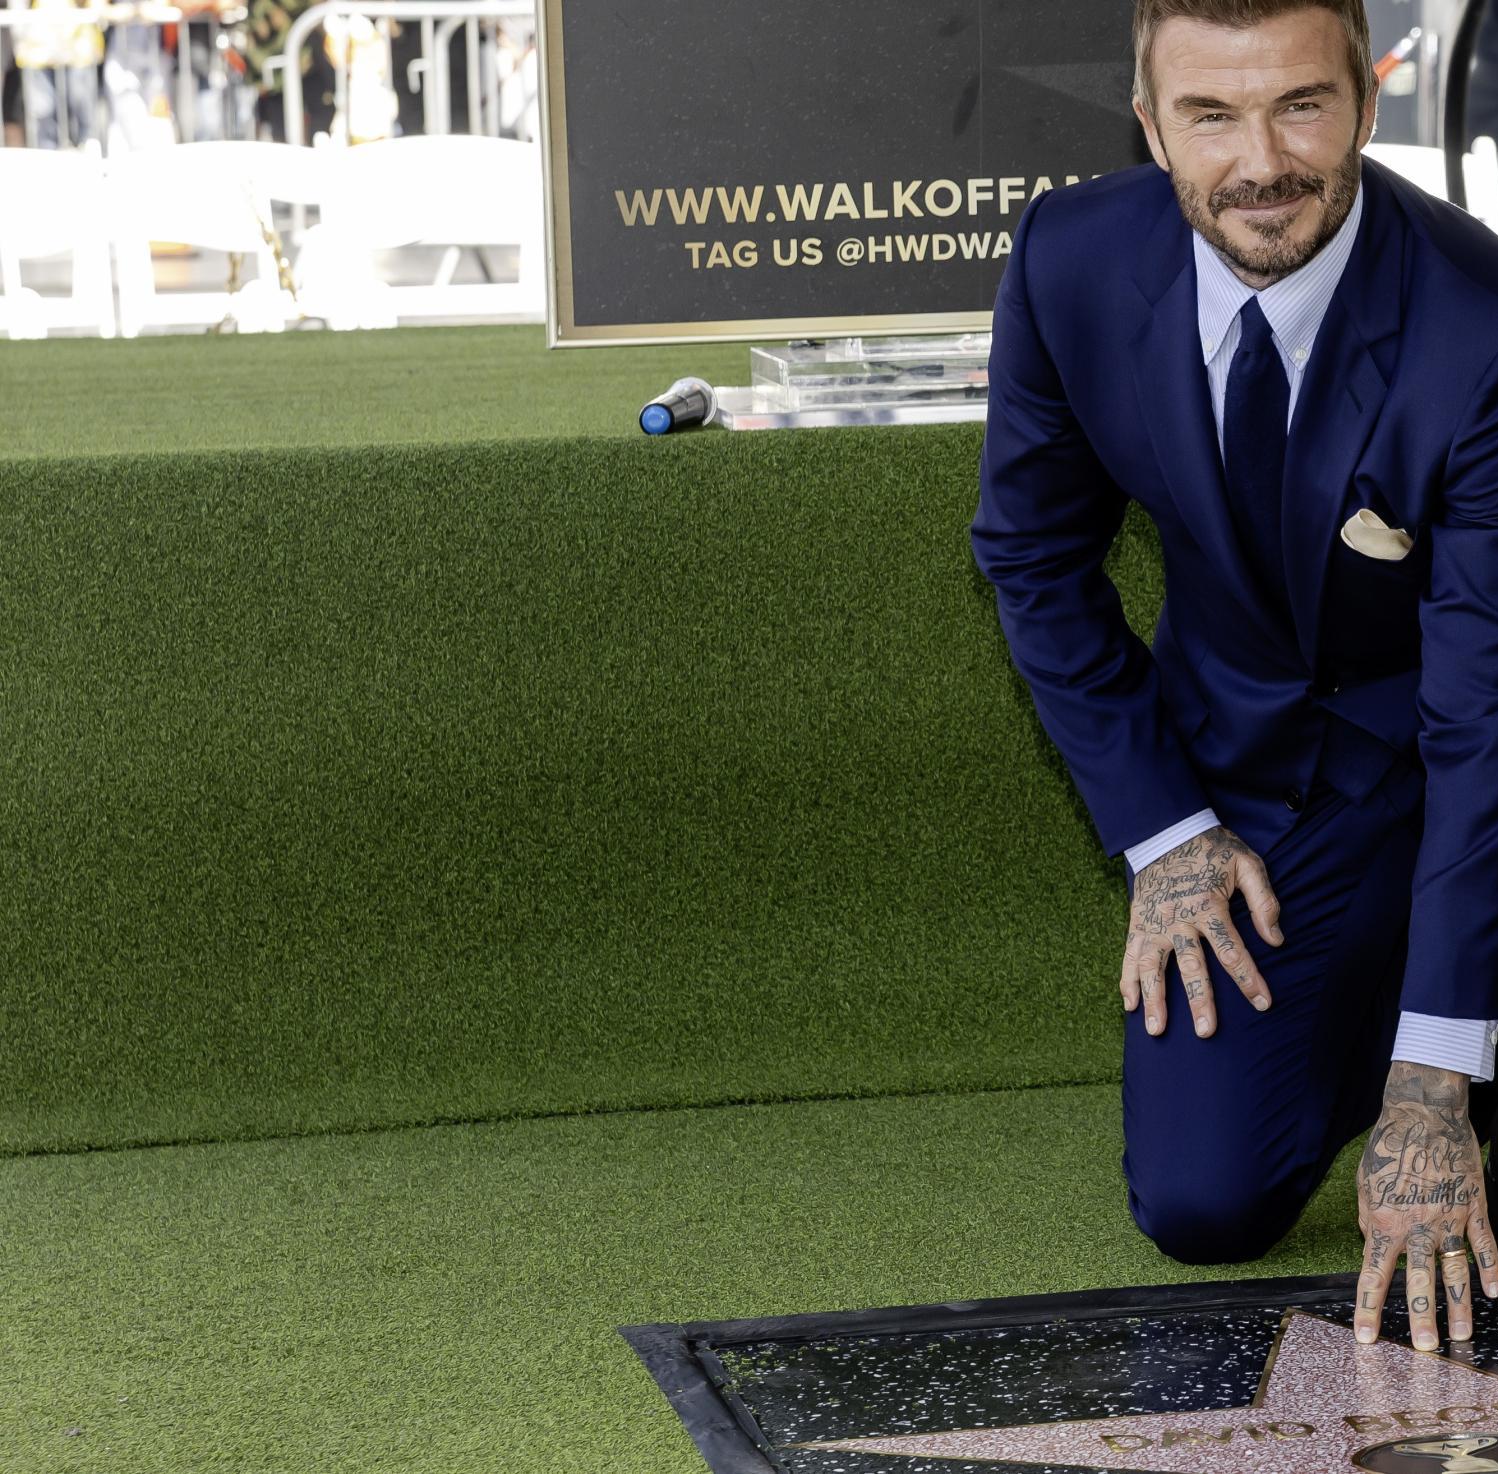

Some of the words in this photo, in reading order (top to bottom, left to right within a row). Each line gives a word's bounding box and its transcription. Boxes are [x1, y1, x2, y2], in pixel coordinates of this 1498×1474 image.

[614, 174, 1102, 226] WWW.WALKOFF
[685, 240, 757, 268] TAG
[773, 238, 822, 266] US
[1384, 1121, 1464, 1187] Love
[1100, 1421, 1315, 1452] DAVID
